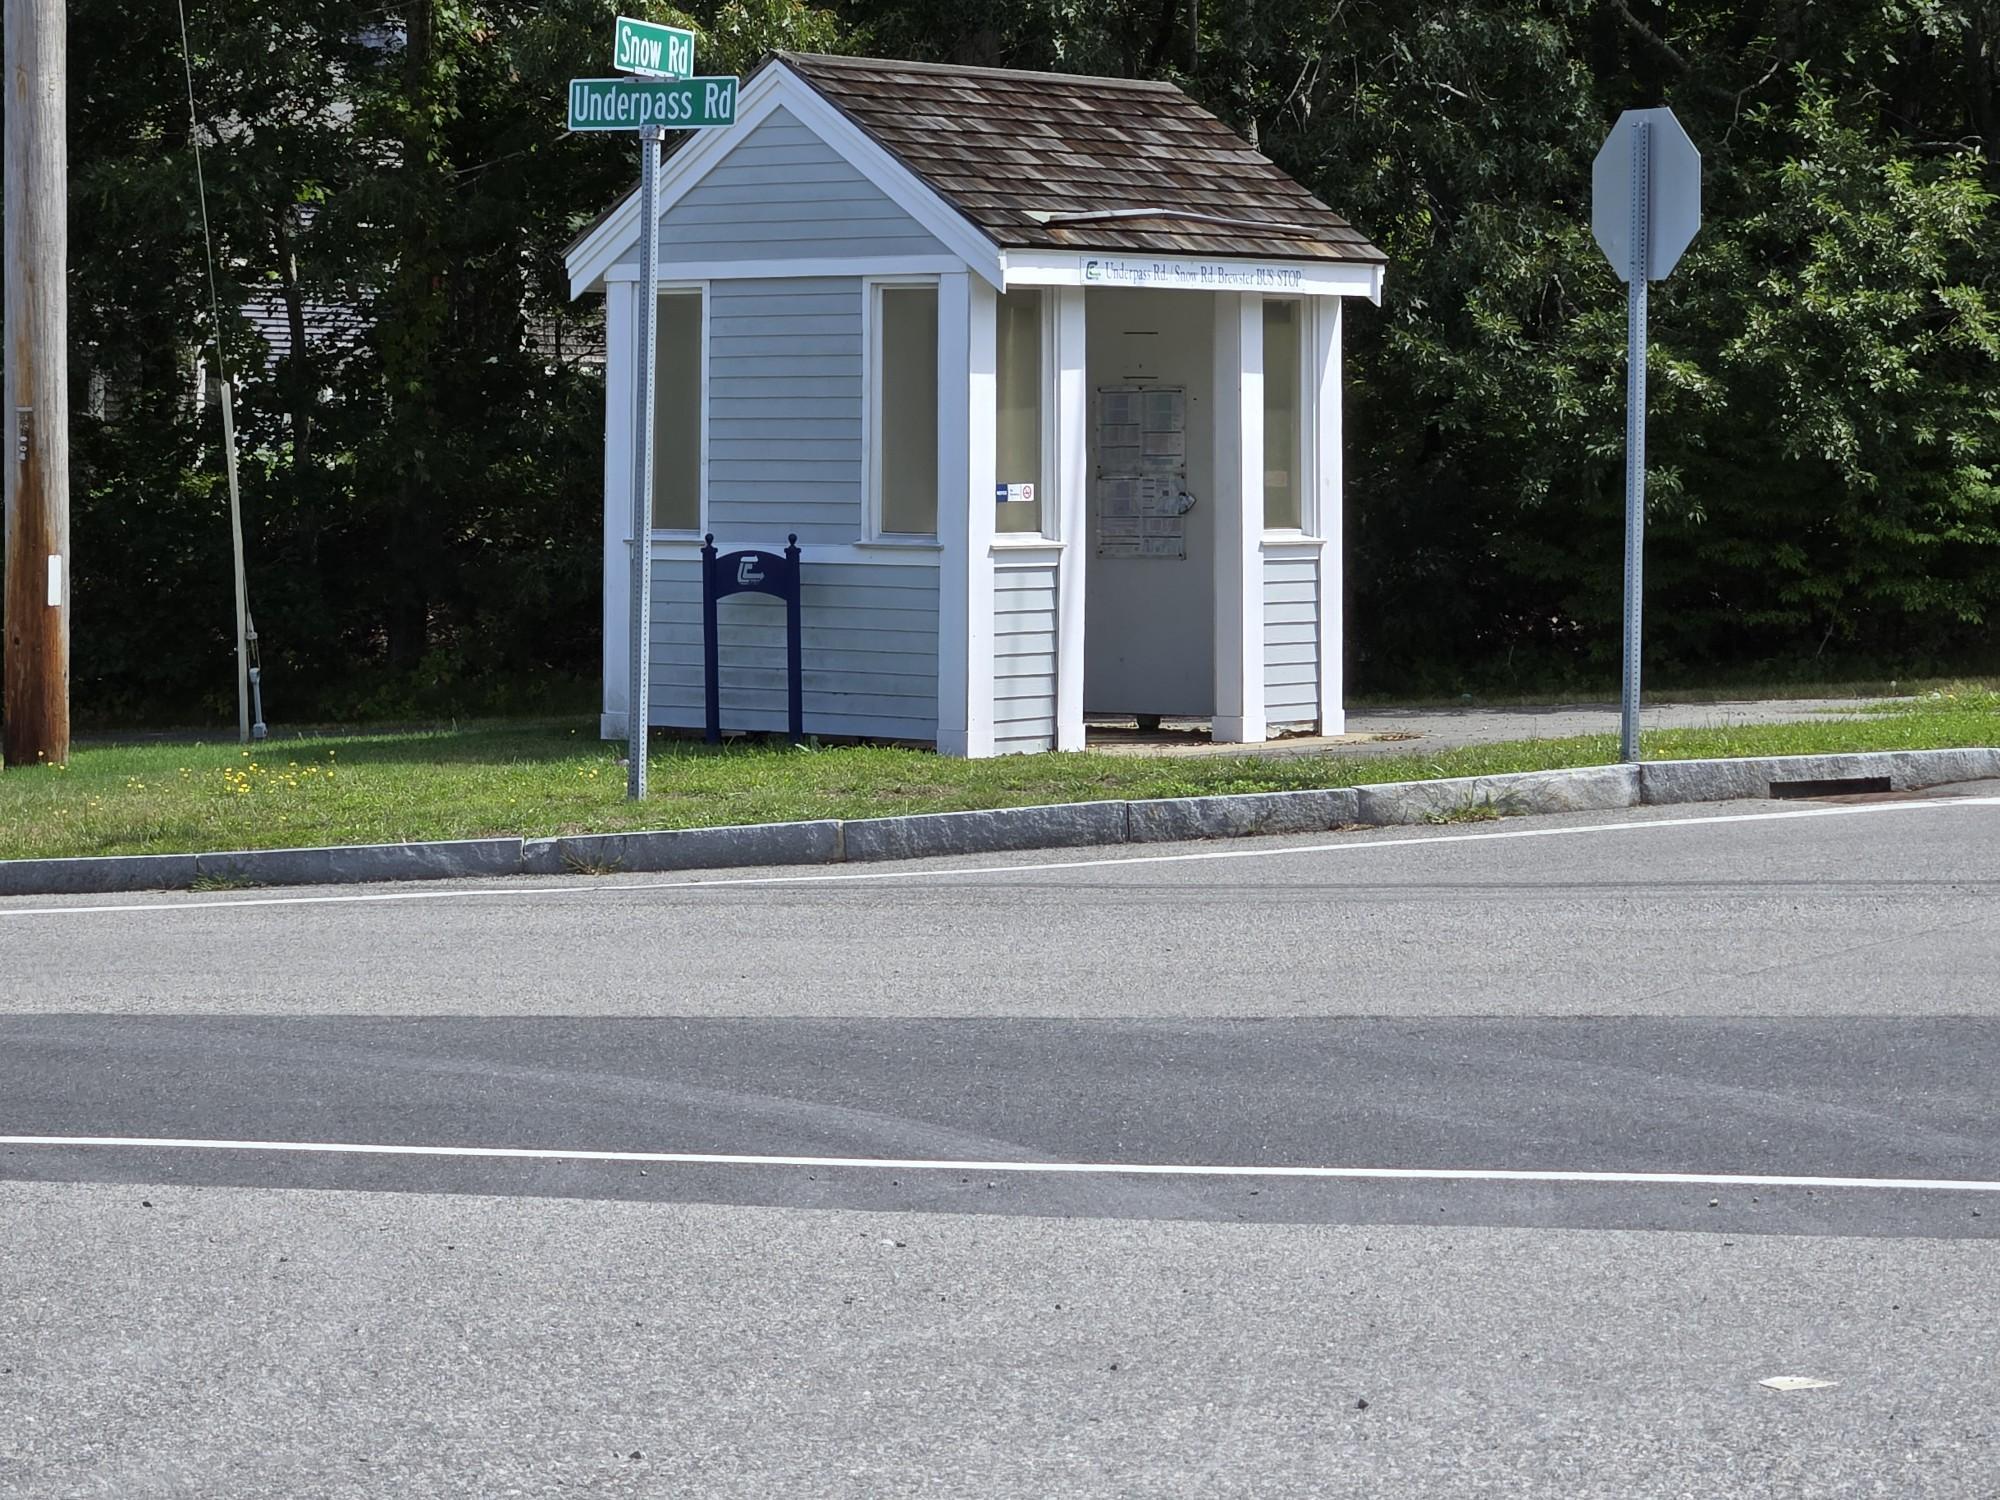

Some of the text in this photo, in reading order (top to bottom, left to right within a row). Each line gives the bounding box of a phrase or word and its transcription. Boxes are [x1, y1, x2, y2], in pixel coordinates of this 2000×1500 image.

[620, 25, 689, 74] Snow Rd
[574, 82, 732, 125] Underpass Rd
[1105, 261, 1151, 284] Underpass
[1153, 263, 1168, 281] Rd.
[1174, 264, 1198, 281] Snow
[1218, 267, 1254, 285] Brewster
[1256, 268, 1274, 286] BUS
[1277, 269, 1302, 288] STOP
